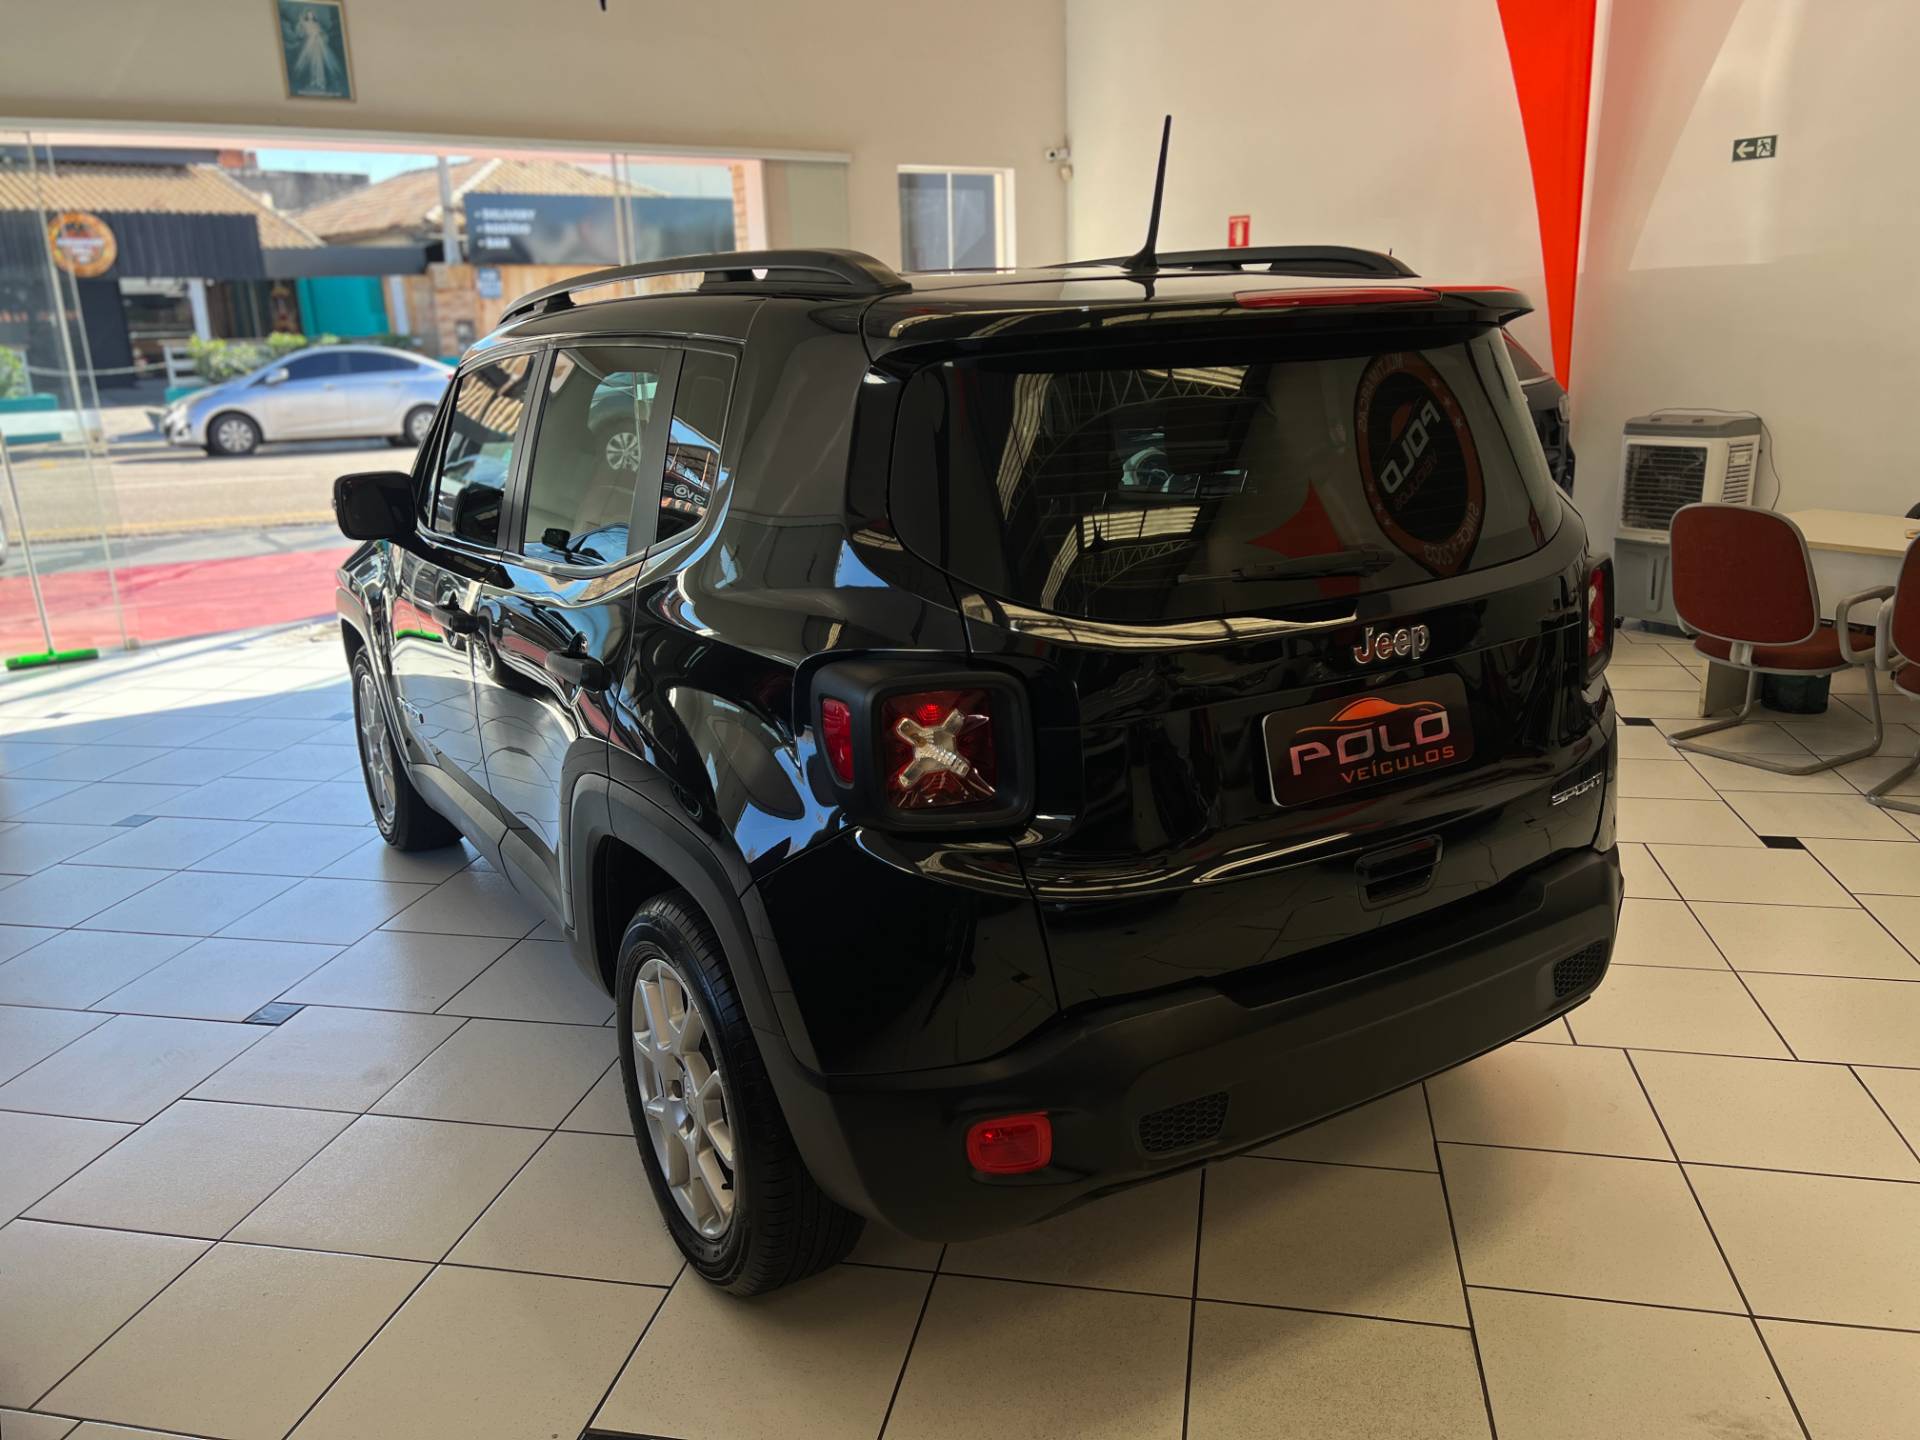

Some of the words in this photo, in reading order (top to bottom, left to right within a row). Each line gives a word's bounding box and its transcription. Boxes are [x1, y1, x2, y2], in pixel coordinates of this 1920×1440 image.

[1353, 624, 1430, 665] Jeep
[1290, 710, 1450, 776] POLO
[1341, 745, 1456, 784] VEÍCULOS
[1552, 771, 1602, 806] SPORT
